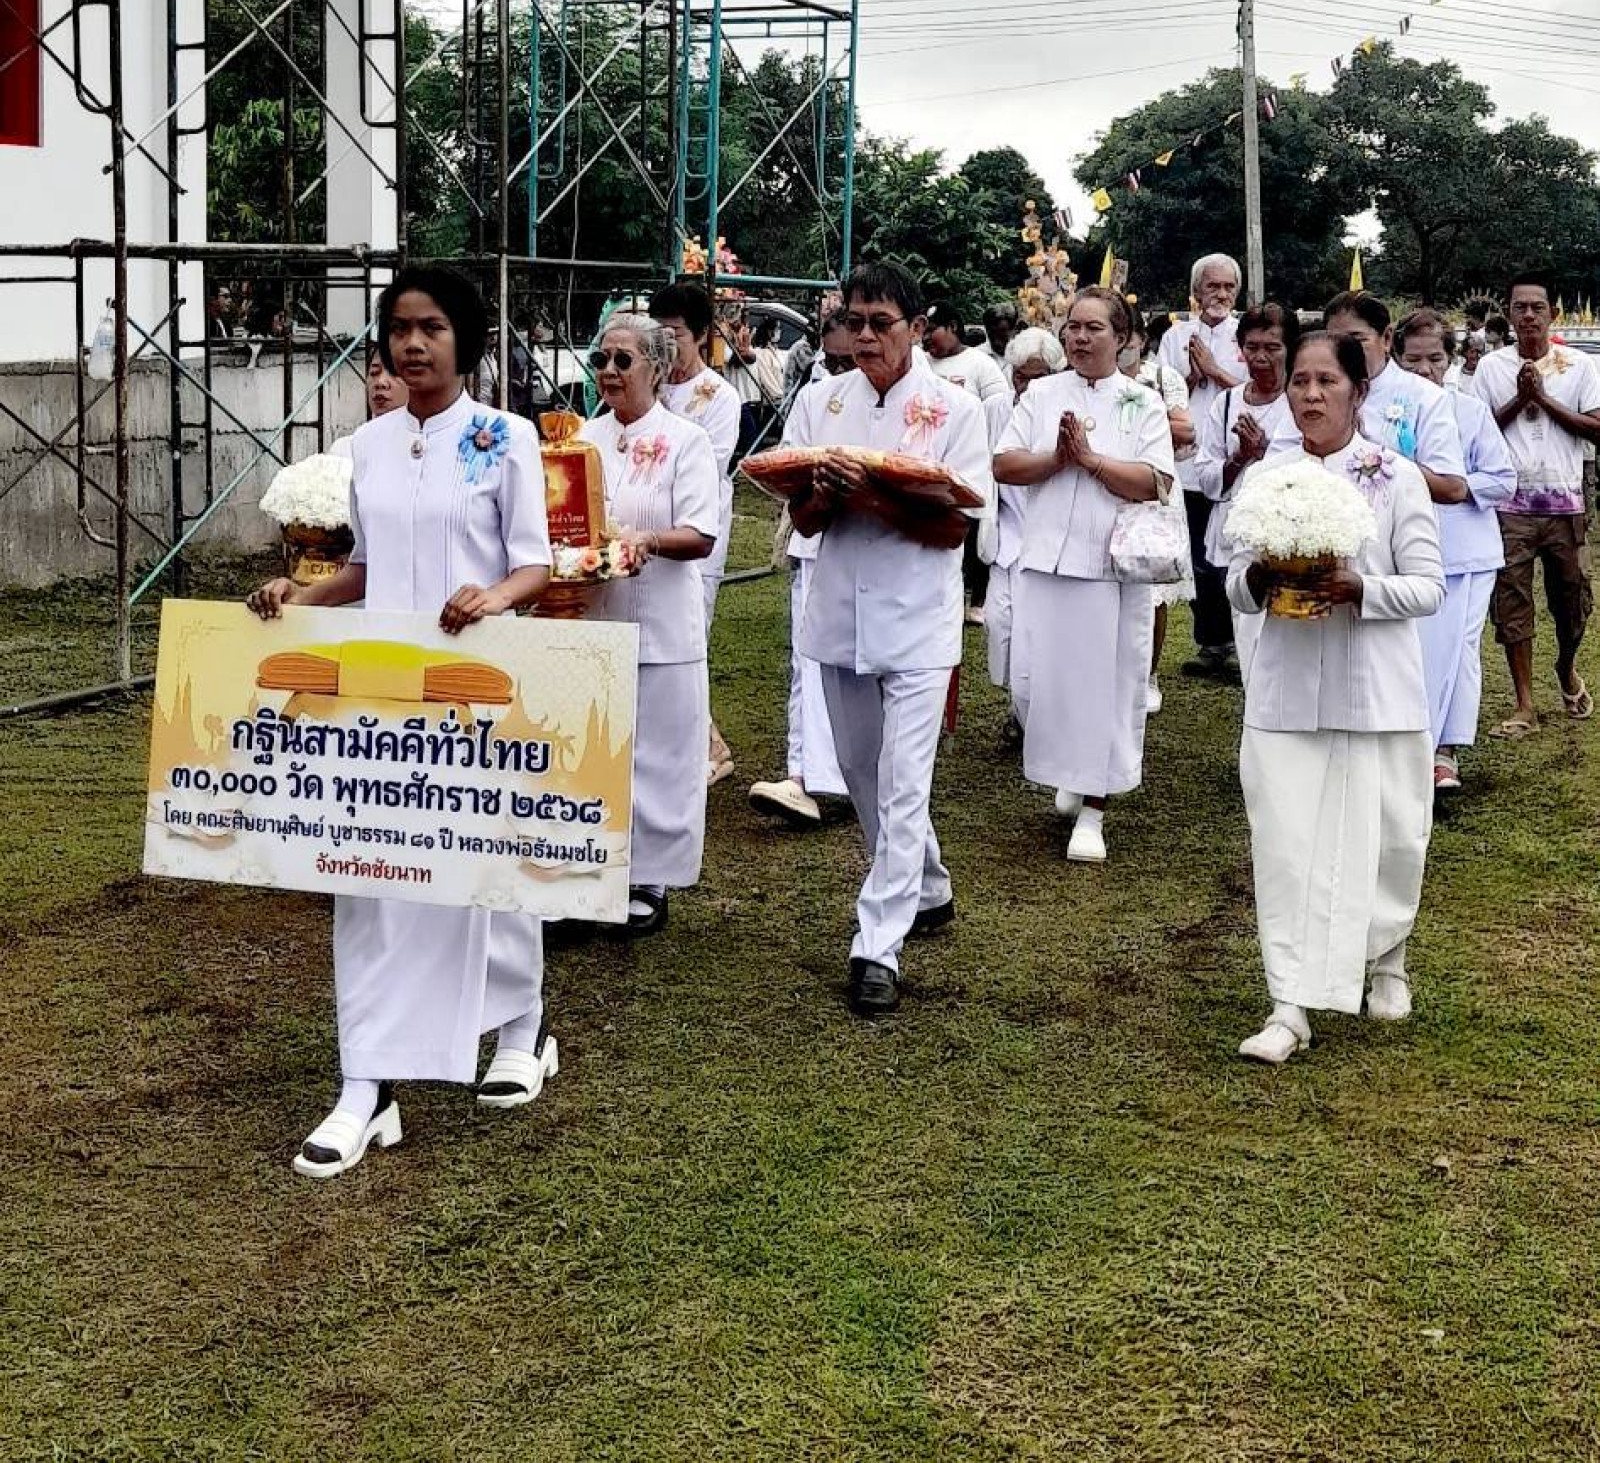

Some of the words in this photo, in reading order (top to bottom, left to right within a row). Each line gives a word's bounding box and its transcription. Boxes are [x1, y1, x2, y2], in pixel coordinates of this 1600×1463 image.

[232, 707, 550, 773] กฐินสามัคคีทั่วไทย
[171, 767, 278, 796] ๓๐,๐๐๐
[286, 761, 324, 800] วัด
[333, 770, 502, 817] พุทธศักราช
[511, 790, 603, 823] ๒๕๖๘
[163, 800, 192, 824] โดย
[196, 808, 324, 842] คณะศิษยานุศิษย์
[328, 824, 406, 847] บูชาธรรม
[410, 832, 435, 849] ๘๑
[439, 826, 454, 850] ปี
[458, 834, 608, 864] หลวงพ่อธัมมชโย
[316, 851, 432, 884] จังหวัดชัยนาท
